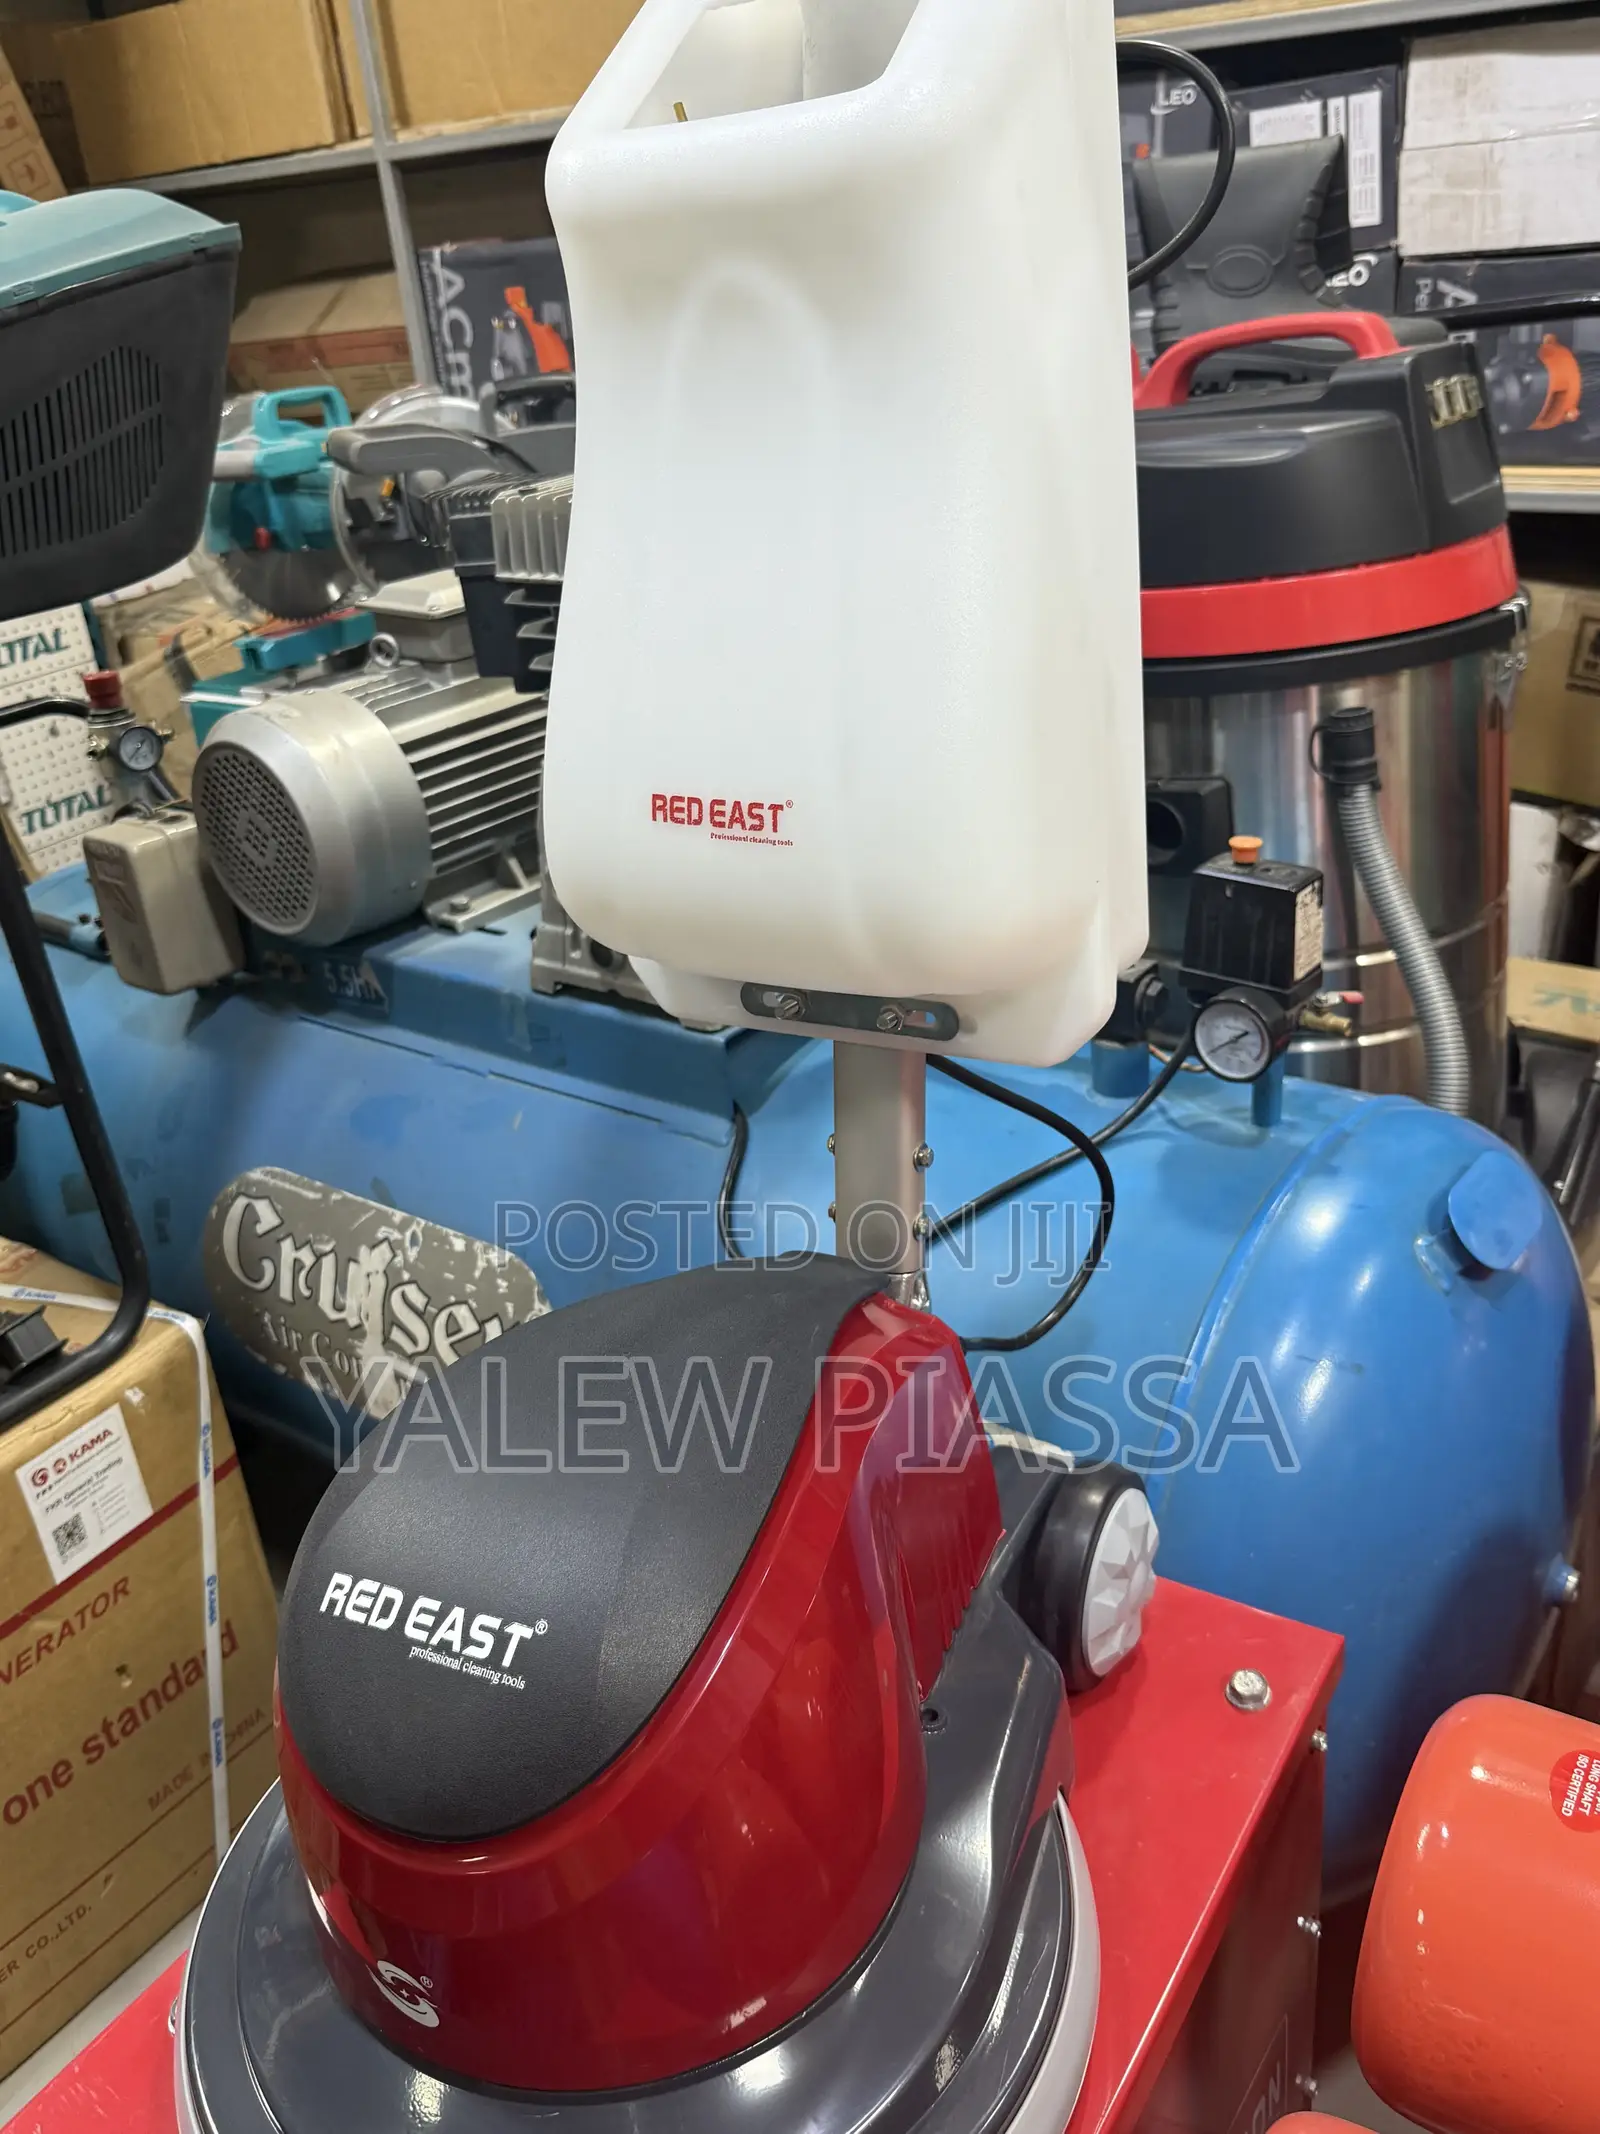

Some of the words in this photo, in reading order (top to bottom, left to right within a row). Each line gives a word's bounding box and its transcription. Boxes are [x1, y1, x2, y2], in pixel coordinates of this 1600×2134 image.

[1158, 88, 1198, 106] LEO
[21, 785, 113, 834] TOTAL
[651, 793, 704, 826] RED
[749, 836, 777, 847] cleaning
[777, 839, 794, 847] tools
[68, 1428, 114, 1463] KAMA
[319, 1571, 405, 1632] RED
[408, 1645, 463, 1671] professional
[462, 1660, 502, 1686] cleaning
[501, 1673, 527, 1690] tools
[3, 1758, 75, 1826] one
[82, 1619, 240, 1766] standad
[1576, 1753, 1590, 1769] ISO
[147, 1762, 196, 1812] MADE
[1561, 1768, 1585, 1817] CERTIFIED
[1578, 1782, 1597, 1817] SHAFT
